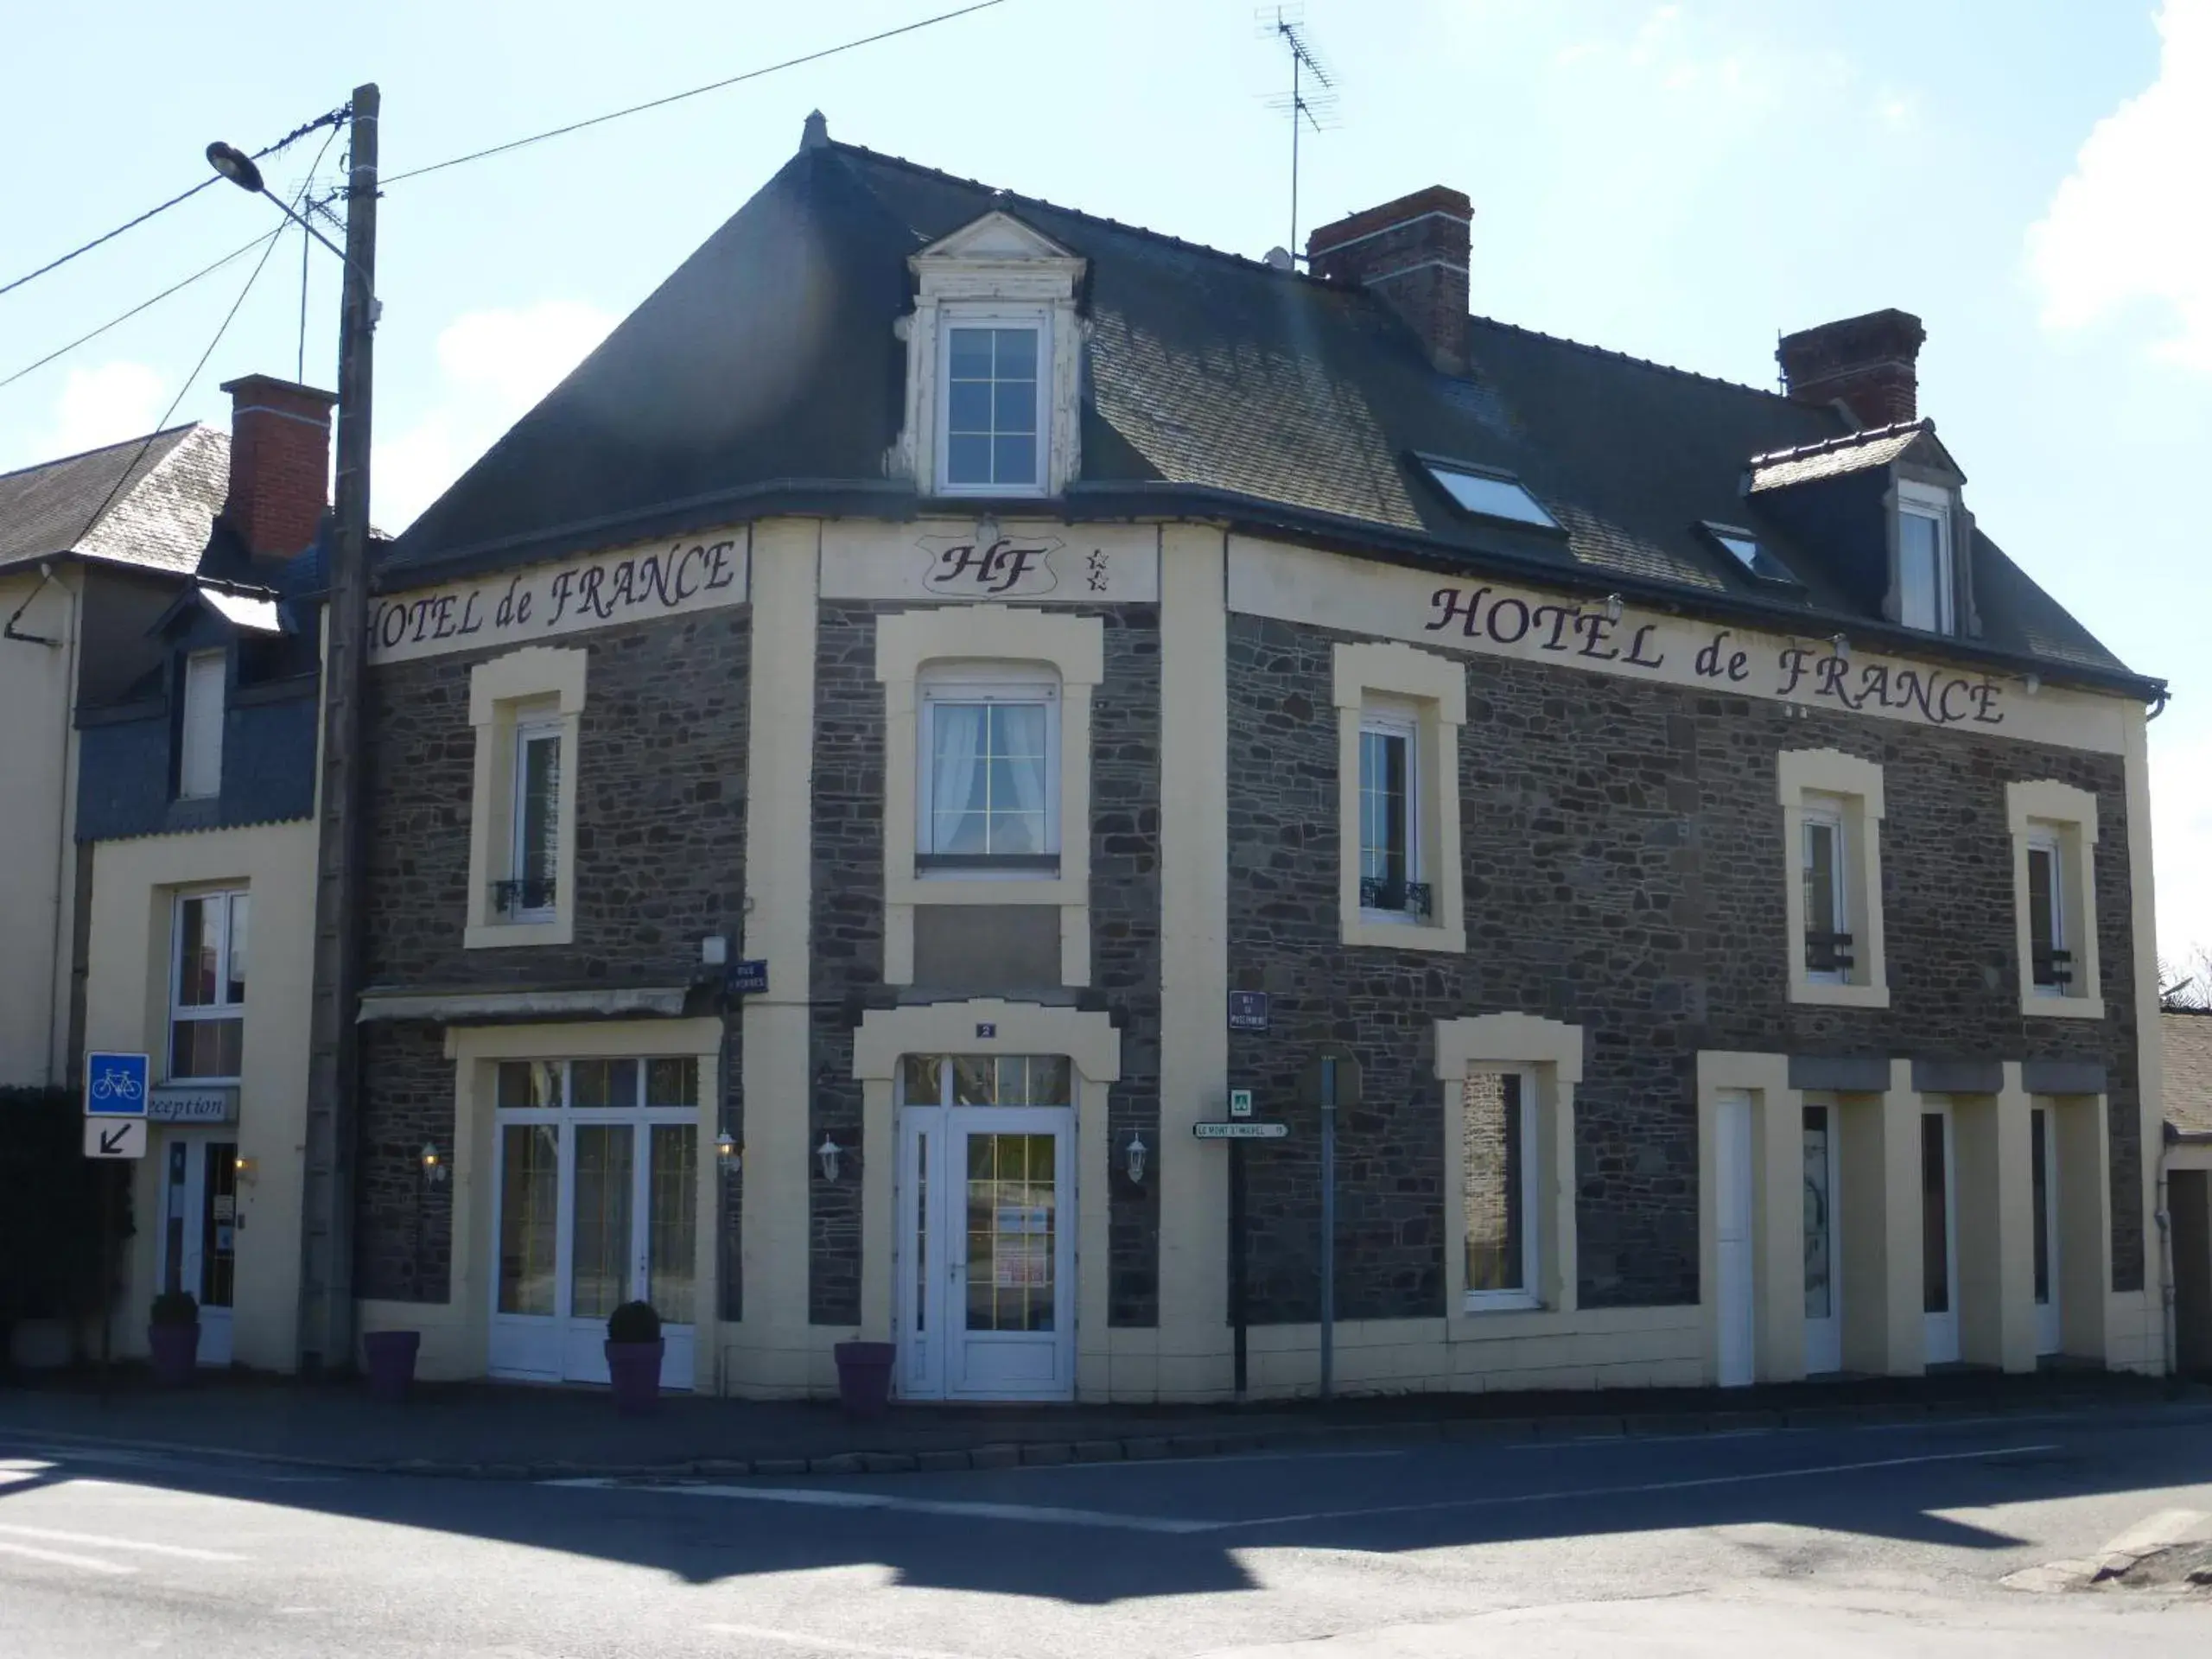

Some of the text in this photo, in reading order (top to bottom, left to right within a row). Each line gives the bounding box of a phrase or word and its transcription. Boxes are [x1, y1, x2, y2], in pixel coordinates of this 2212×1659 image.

[495, 575, 532, 628] de
[546, 541, 735, 627] FRANCE
[1424, 587, 2005, 725] HOTEL de FRANCE
[148, 1096, 223, 1120] eception
